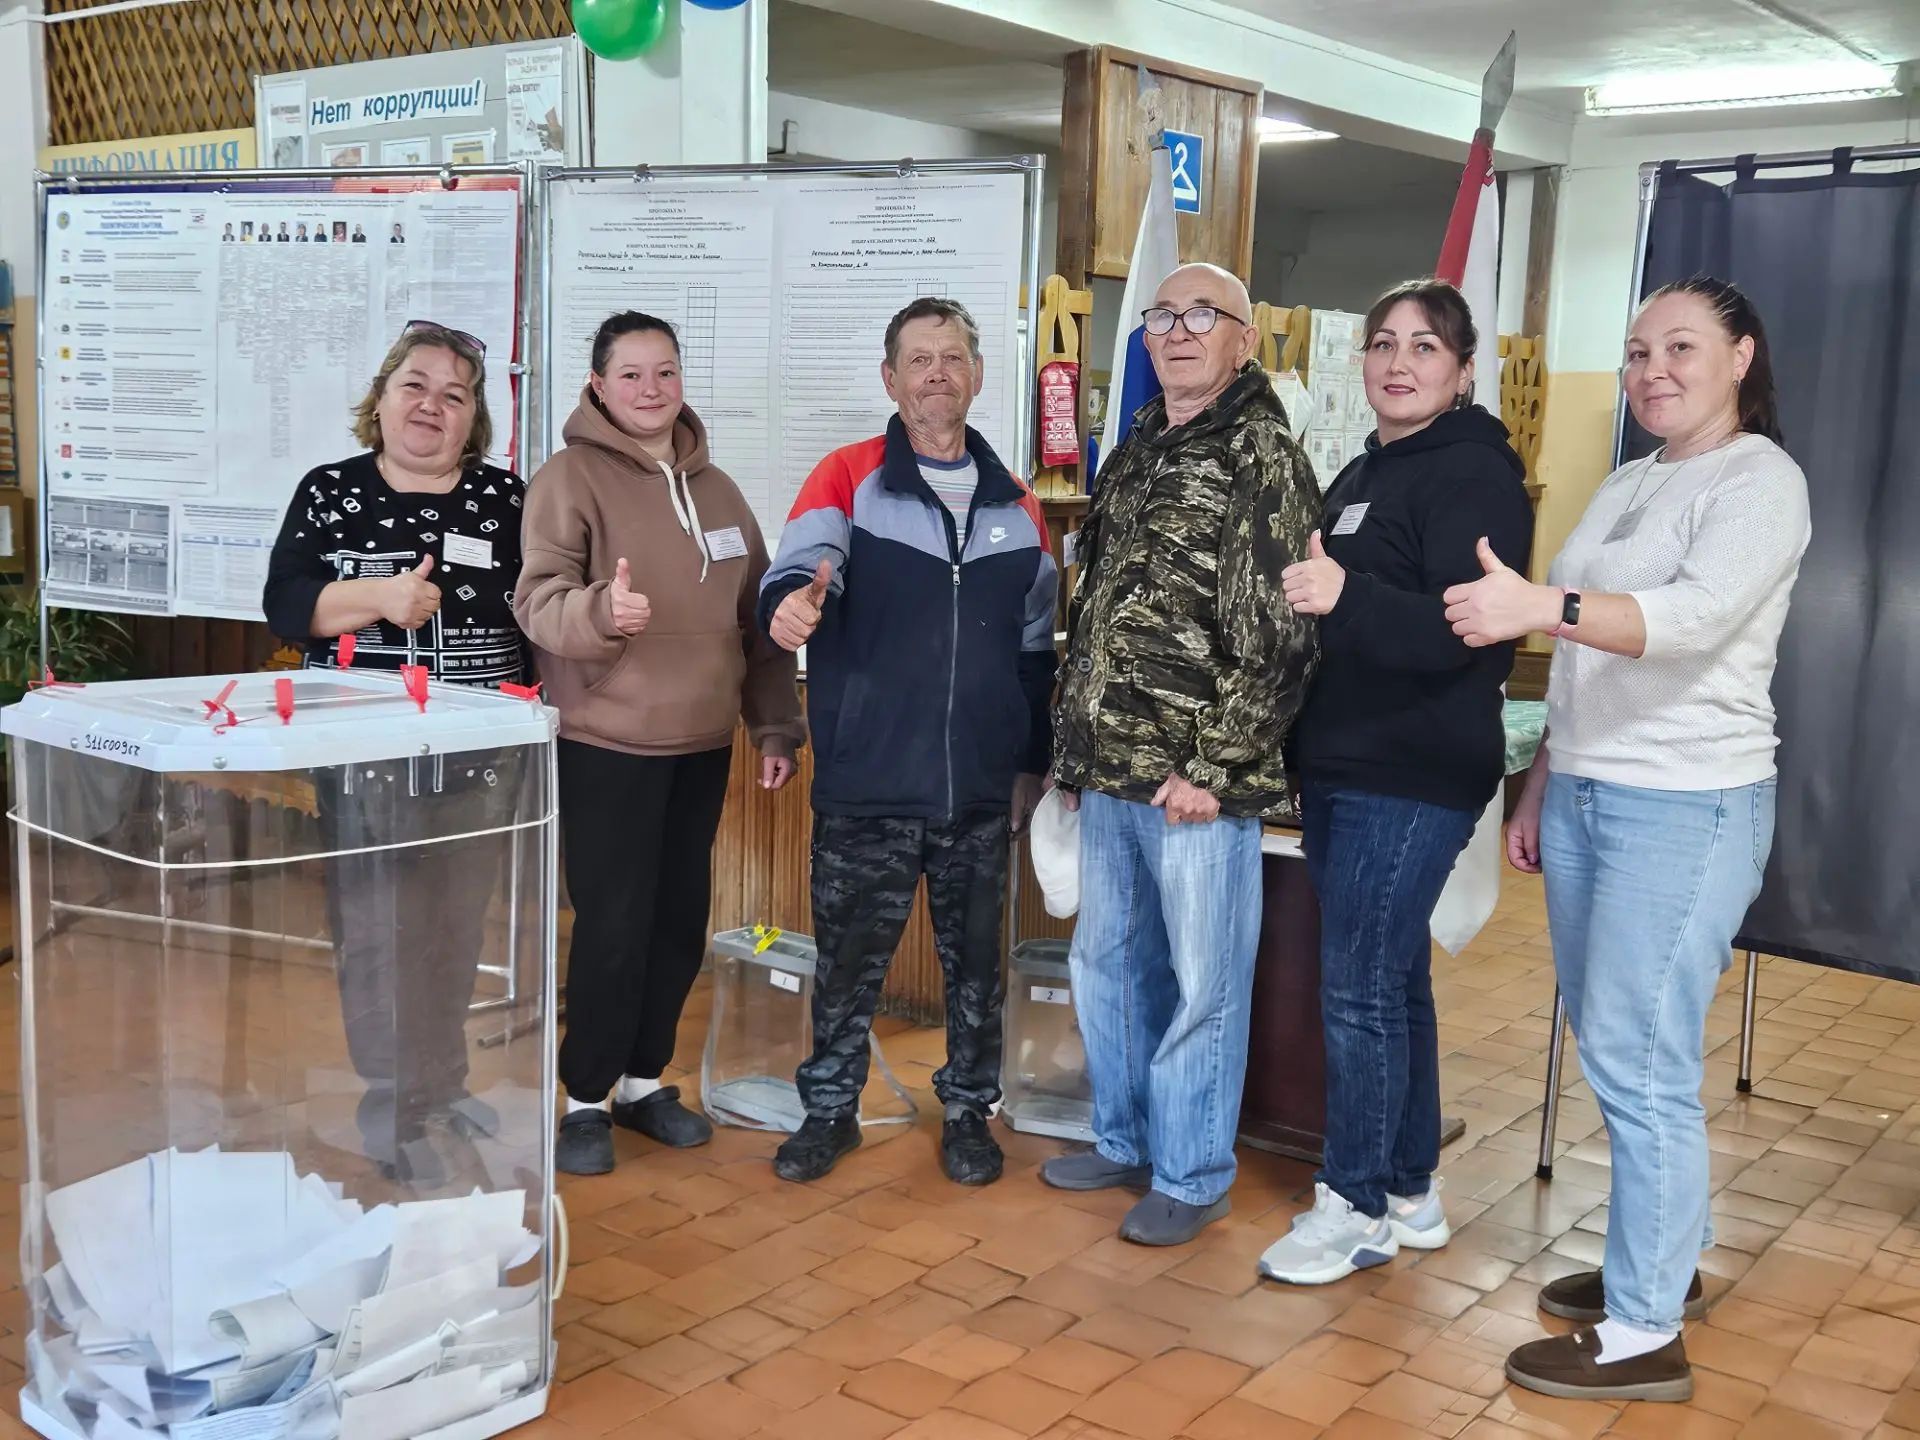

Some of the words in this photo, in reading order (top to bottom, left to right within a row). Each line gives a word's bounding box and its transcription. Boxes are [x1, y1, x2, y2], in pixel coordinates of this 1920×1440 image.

[311, 100, 351, 126] Нет
[363, 79, 481, 121] коррупции!
[443, 628, 460, 636] THIS
[462, 628, 469, 636] IS
[443, 659, 460, 667] THIS
[462, 659, 469, 667] IS
[470, 658, 484, 666] THE
[1046, 990, 1053, 1000] 2
